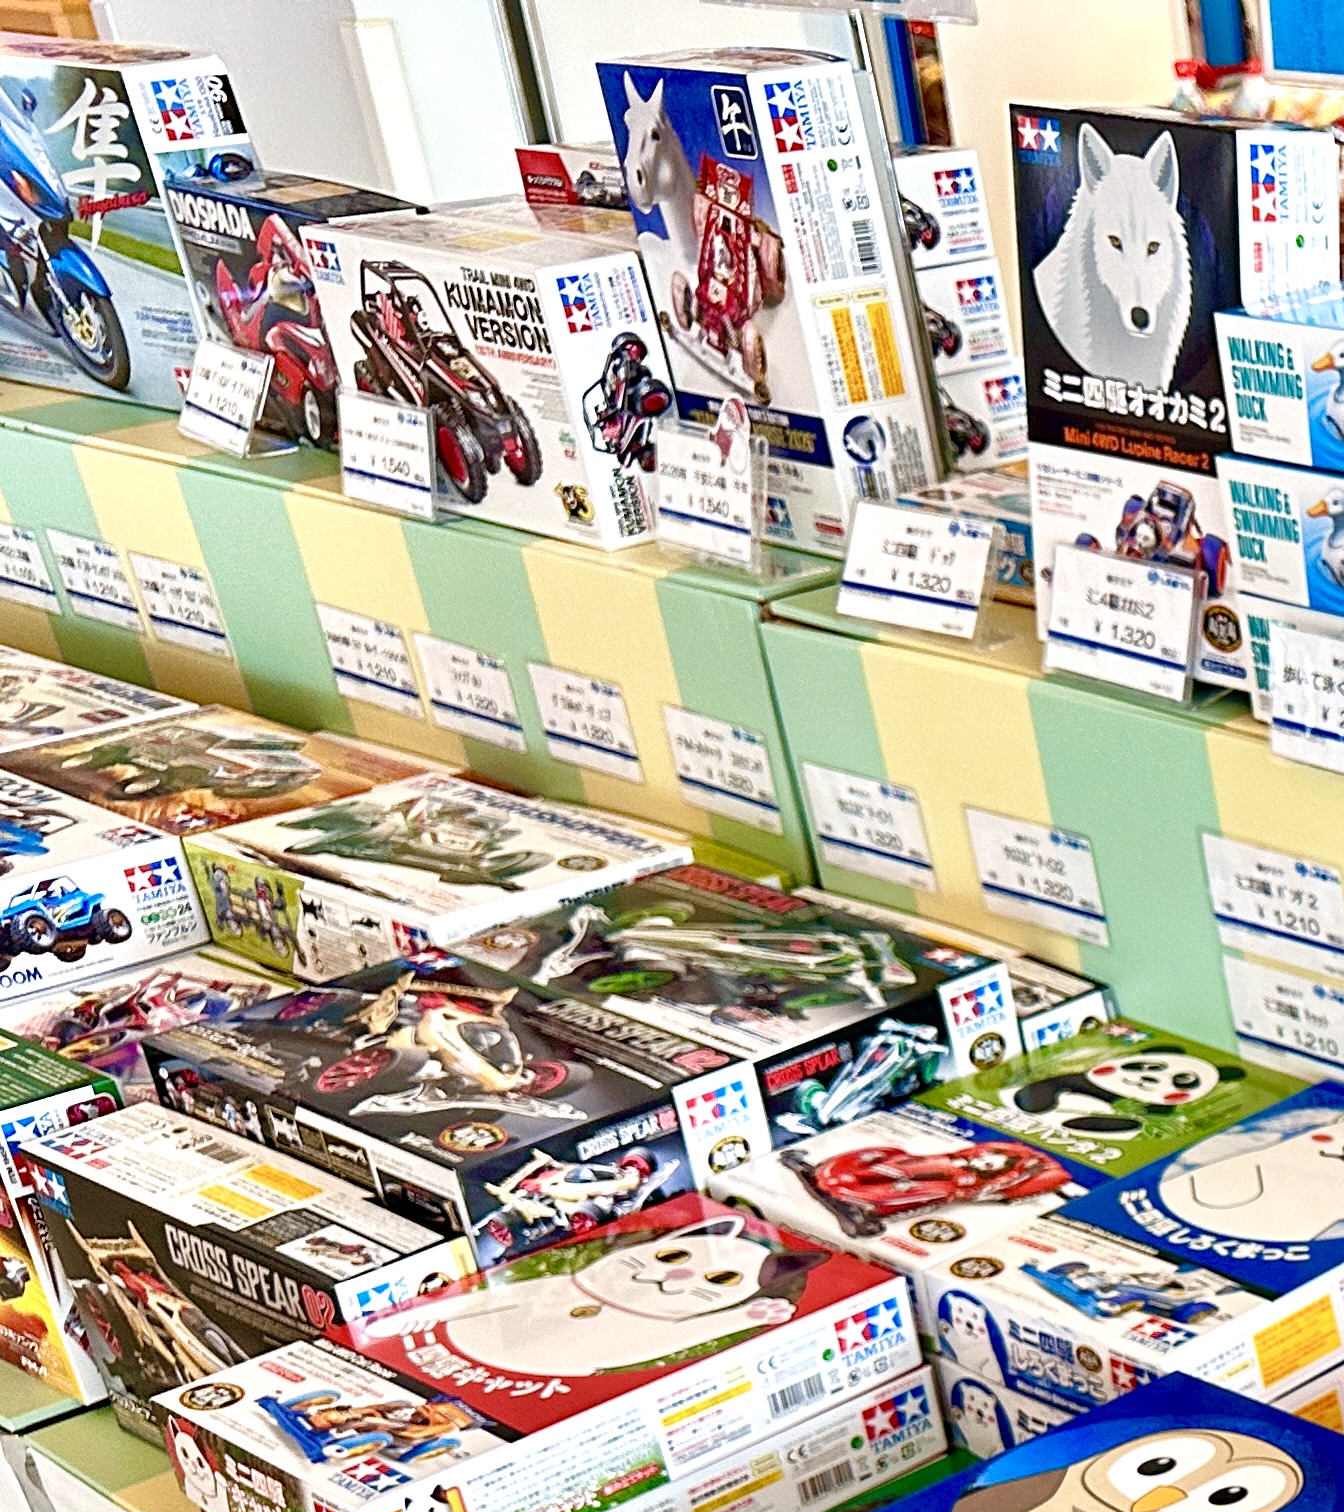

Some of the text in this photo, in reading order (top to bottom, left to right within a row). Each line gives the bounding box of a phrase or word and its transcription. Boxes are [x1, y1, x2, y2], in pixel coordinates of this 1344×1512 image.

[793, 79, 815, 149] TAMIYA
[1276, 143, 1290, 223] TAMIYA
[167, 191, 256, 241] DIOSPADA
[445, 281, 544, 325] KUMAMON
[464, 314, 550, 354] VERSION
[1228, 336, 1294, 370] WALKING &
[1043, 368, 1227, 434] ミニ四駆オオカミ2
[1232, 365, 1303, 400] SWIMMING
[1237, 393, 1268, 422] DUCK
[1063, 425, 1091, 447] Mini
[1163, 444, 1200, 468] Racer
[1201, 455, 1209, 470] 2
[1229, 480, 1282, 514] WALKING
[1233, 508, 1300, 544] SWIMMING
[1237, 535, 1268, 564] DUCK
[163, 1223, 335, 1330] CROSS SPEAR 02
[842, 1332, 906, 1368] TAMIYA
[869, 1418, 932, 1453] TAMIYA
